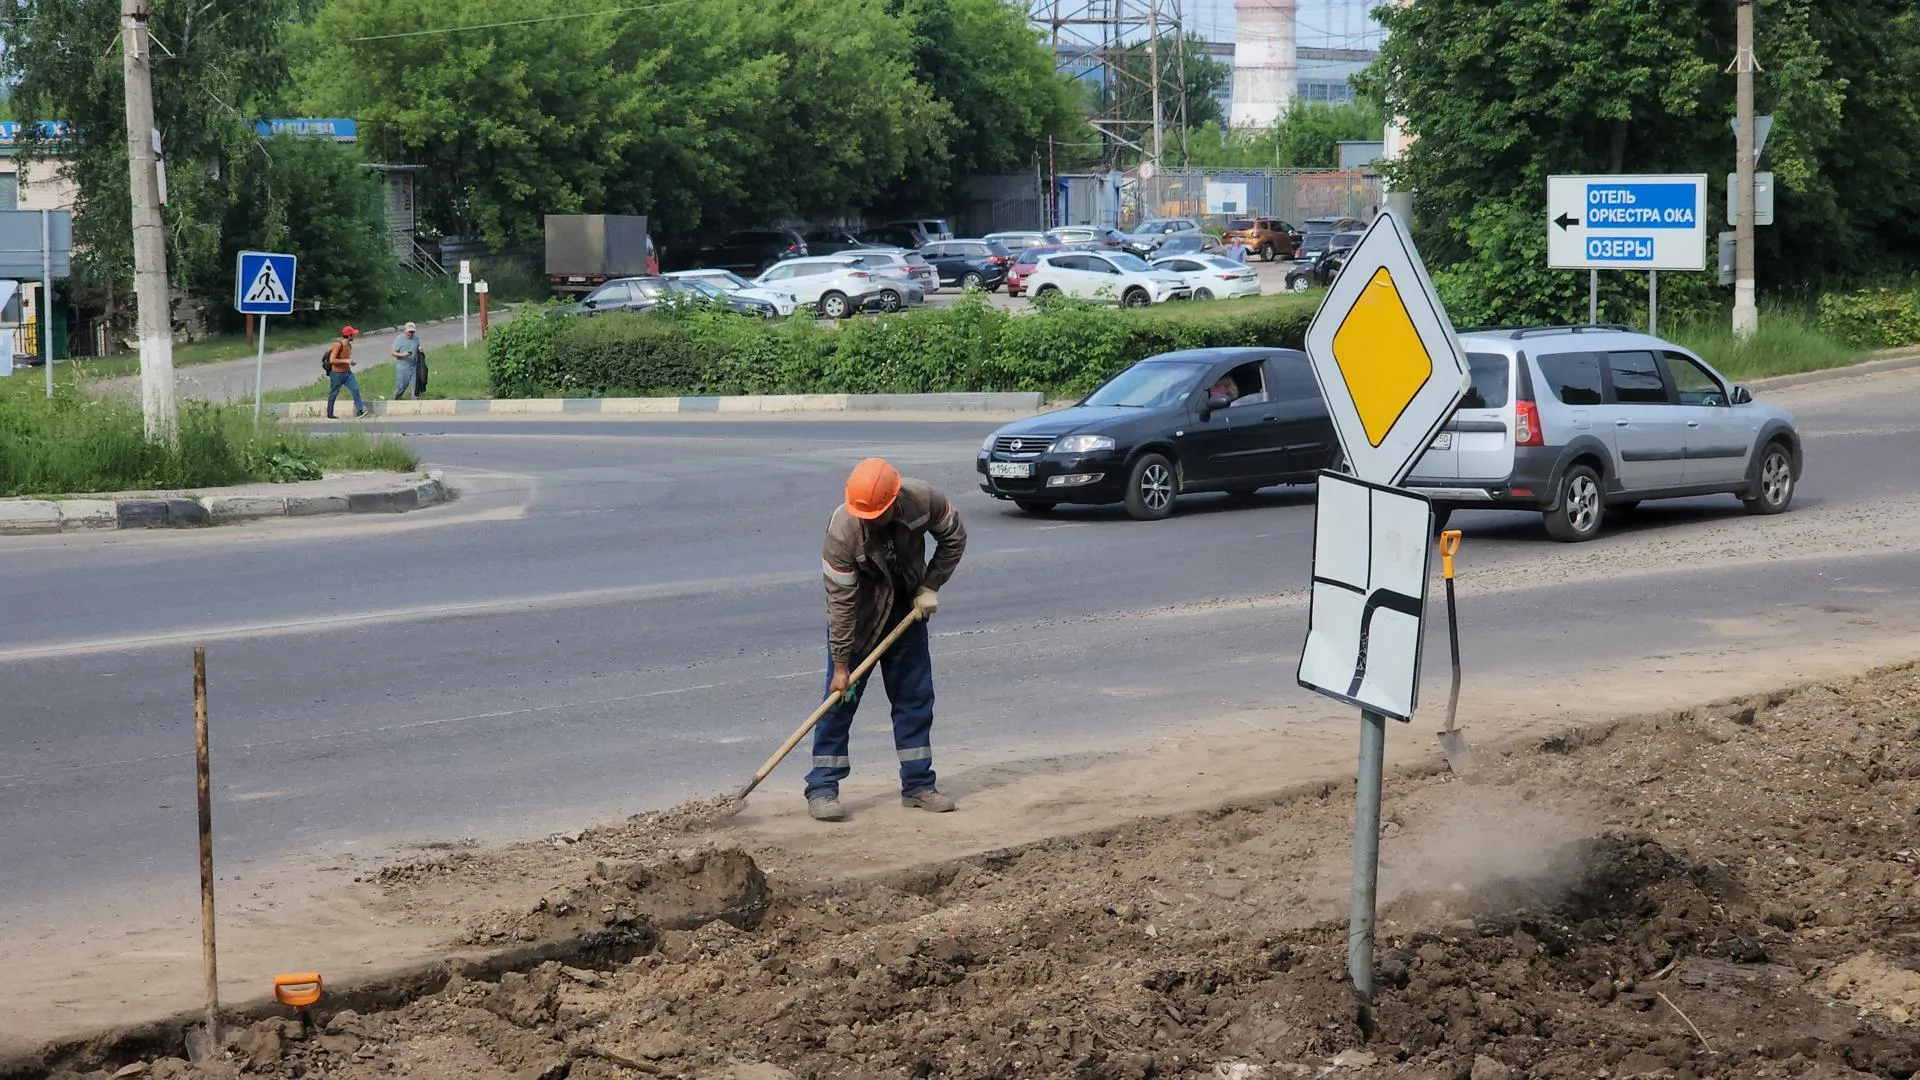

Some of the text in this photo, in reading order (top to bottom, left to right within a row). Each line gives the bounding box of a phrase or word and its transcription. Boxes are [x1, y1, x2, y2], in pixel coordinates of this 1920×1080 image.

[1589, 190, 1636, 204] ОТЕЛЬ
[1589, 208, 1694, 223] ОРКЕСТРА ОКА
[1588, 240, 1651, 257] ОЗЕРЫ
